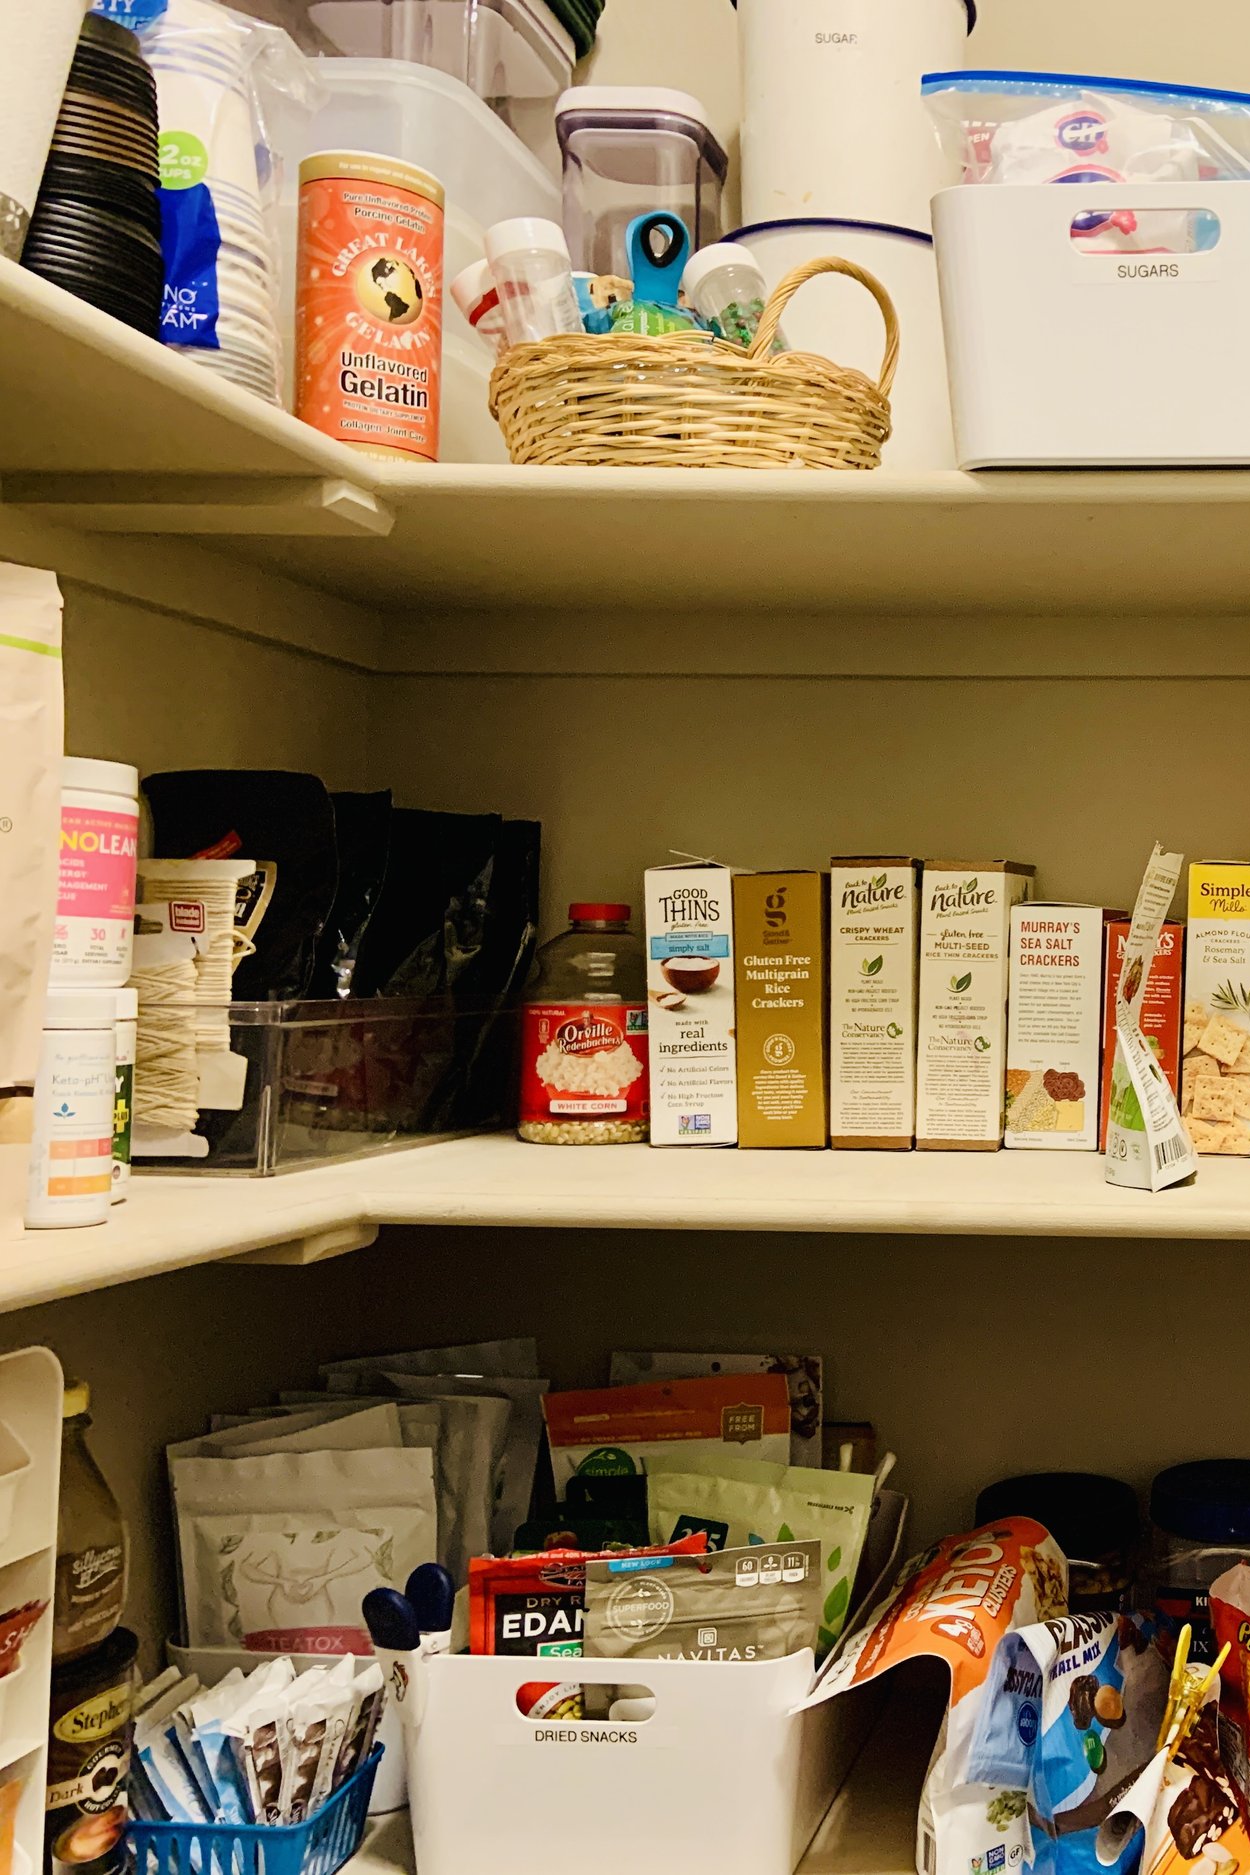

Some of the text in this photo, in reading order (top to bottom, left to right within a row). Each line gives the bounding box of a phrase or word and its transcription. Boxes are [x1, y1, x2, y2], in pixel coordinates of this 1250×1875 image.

[815, 33, 858, 44] SUGAR
[354, 207, 394, 222] Porcine
[332, 232, 437, 299] GREAT LAKES
[1117, 264, 1179, 279] SUGARS
[345, 311, 431, 351] GELATIN
[341, 351, 428, 384] Unflavored
[340, 370, 428, 408] Gelatin
[340, 419, 382, 434] Collagen
[60, 833, 136, 857] NOLEAN
[673, 888, 708, 900] GOOD
[841, 882, 904, 908] nature
[930, 886, 995, 912] nature
[659, 895, 720, 922] THINS
[1210, 899, 1246, 913] Mills
[840, 926, 870, 934] CRISPY
[1020, 921, 1080, 934] MURRAY'S
[940, 929, 984, 941] gluten free
[1196, 930, 1229, 940] ALMOND
[669, 942, 710, 953] simply salt
[935, 942, 990, 951] MULTI-SEED
[1020, 938, 1073, 950] SEA SALT
[1204, 945, 1246, 955] Rosemary
[743, 955, 811, 966] Gluten Free
[1020, 954, 1080, 967] CRACKERS
[1212, 956, 1246, 964] Sea Salt
[746, 968, 809, 981] Multigrain
[765, 983, 790, 994] Rice
[752, 998, 804, 1008] Crackers
[564, 1023, 612, 1042] Orville
[680, 1028, 705, 1039] real
[854, 1022, 885, 1032] Nature
[659, 1041, 728, 1055] ingredients
[729, 1414, 755, 1424] FREE
[729, 1423, 756, 1432] FROM
[742, 1561, 753, 1571] 60
[917, 1542, 1004, 1623] KETO
[981, 1563, 1017, 1618] CLUSTERS
[526, 1596, 561, 1609] DRY
[612, 1601, 670, 1613] SUPERFOOD
[268, 1635, 344, 1652] TEATOX
[1082, 1641, 1102, 1664] MIX
[535, 1730, 637, 1743] DRIED SNACKS
[49, 1782, 84, 1805] Dark
